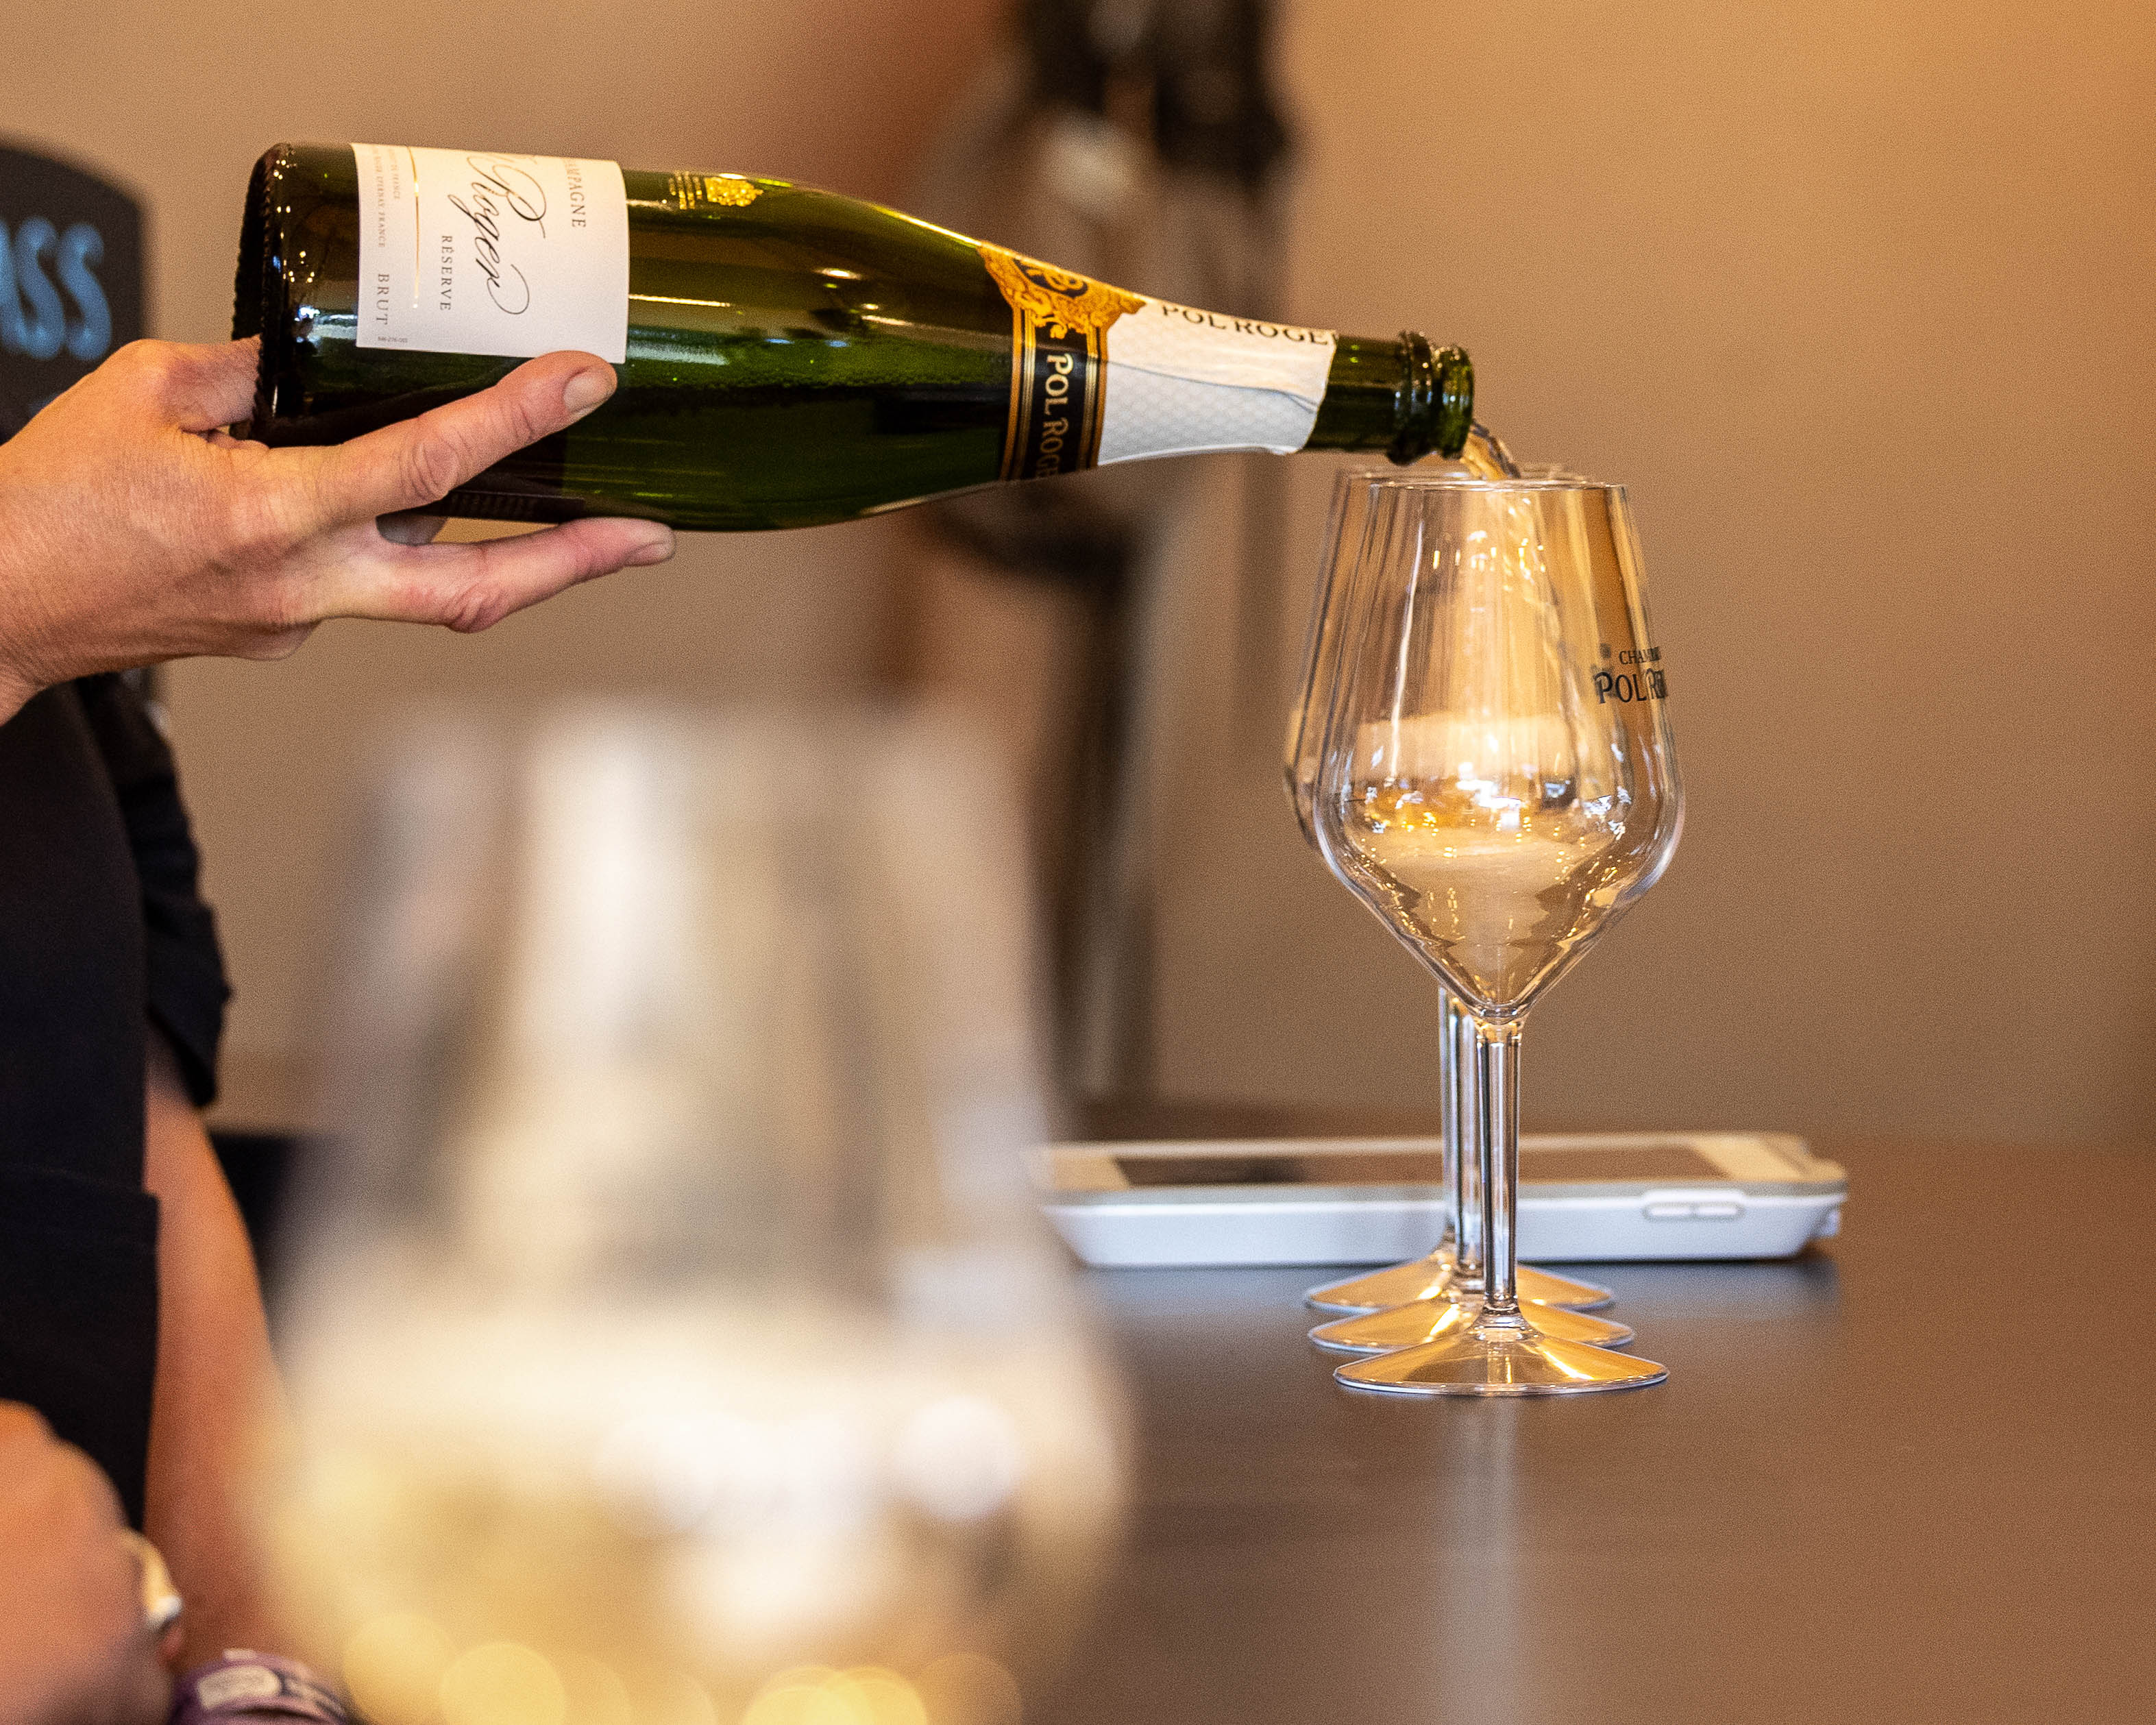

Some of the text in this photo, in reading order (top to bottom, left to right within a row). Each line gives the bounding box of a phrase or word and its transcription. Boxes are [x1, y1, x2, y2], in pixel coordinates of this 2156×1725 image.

[448, 156, 547, 315] Roger
[376, 273, 389, 325] BRUT
[439, 235, 453, 311] RÉSERVE
[1162, 304, 1339, 346] POL ROGE
[1044, 353, 1074, 415] POL
[1593, 670, 1647, 704] POL
